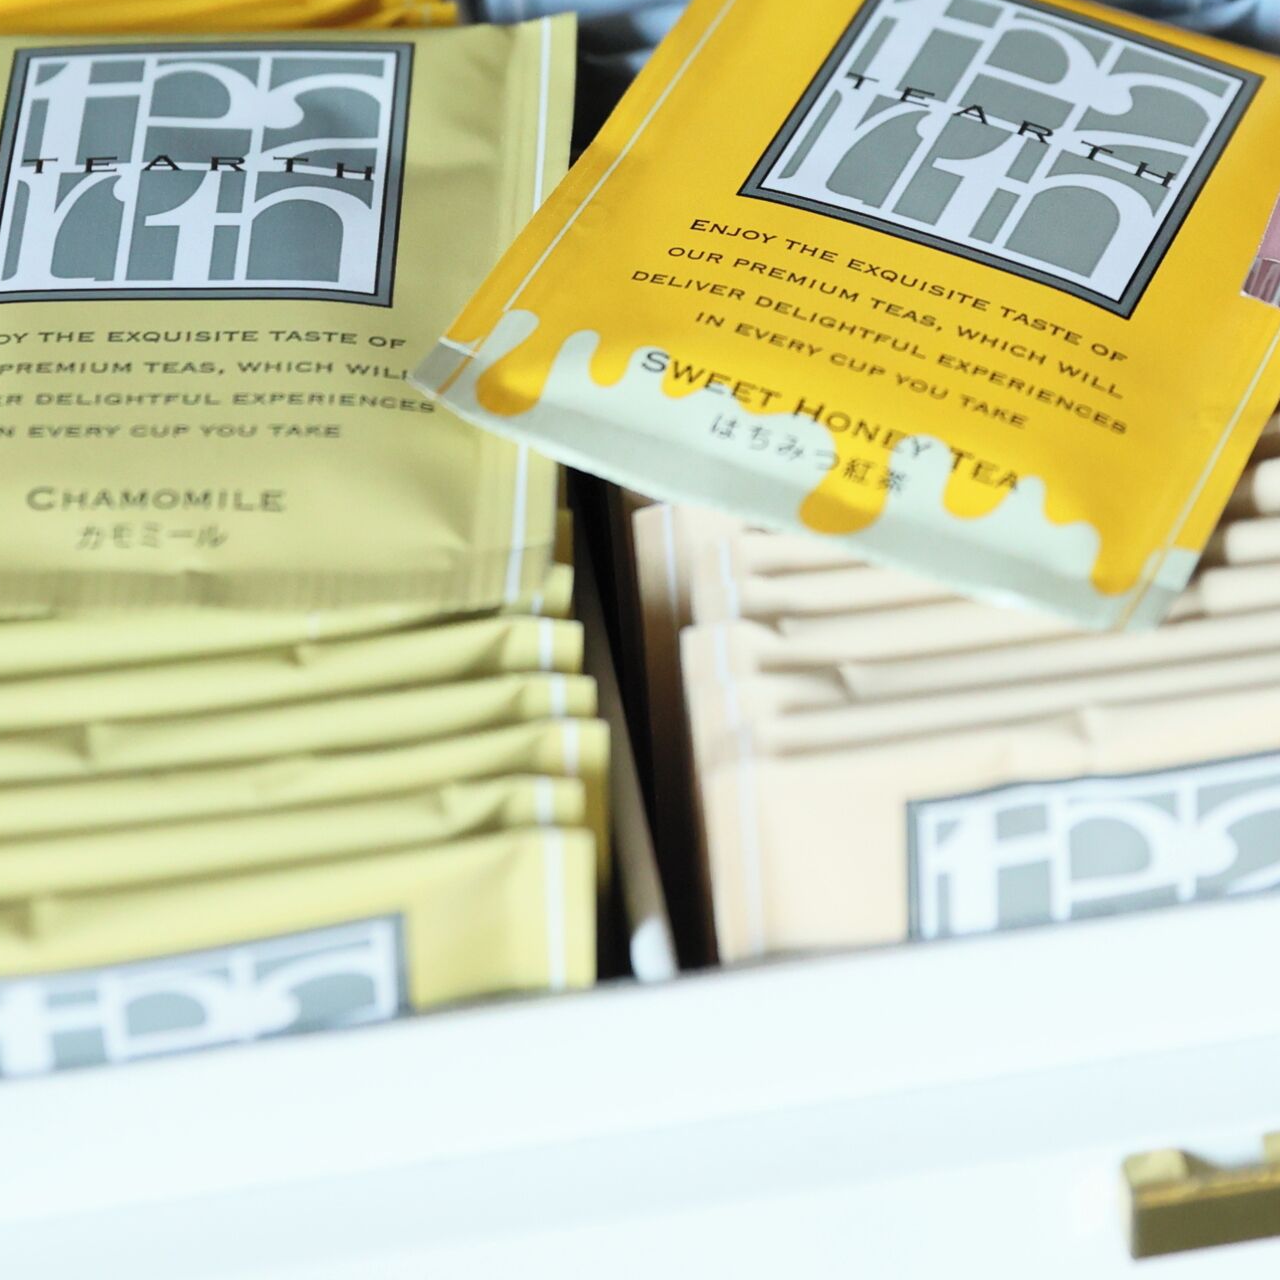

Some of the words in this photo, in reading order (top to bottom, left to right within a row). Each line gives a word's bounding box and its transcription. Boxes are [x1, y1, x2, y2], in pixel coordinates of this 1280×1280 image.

[845, 71, 1176, 188] TEARTH
[23, 154, 375, 182] TEARTH
[689, 218, 778, 245] ENJOY
[784, 238, 839, 264] THE
[847, 259, 992, 312] EXQUISITE
[1000, 305, 1084, 347] TASTE
[1090, 342, 1130, 365] OF
[38, 330, 95, 343] THE
[107, 330, 259, 344] EXQUISITE
[268, 330, 358, 346] TASTE
[367, 335, 407, 350] OF
[667, 246, 725, 266] OUR
[733, 257, 861, 304] PREMIUM
[870, 297, 945, 333] TEAS,
[956, 325, 1048, 367] WHICH
[1057, 361, 1125, 400] WILL
[143, 361, 226, 376] TEAS,
[237, 361, 334, 375] WHICH
[631, 270, 747, 303] DELIVER
[754, 295, 928, 360] DELIGHTFUL
[937, 354, 1129, 436] EXPERIENCES
[695, 312, 726, 329] IN
[734, 322, 823, 357] EVERY
[829, 353, 887, 378] CUP
[896, 372, 950, 401] YOU
[959, 394, 1029, 430] TAKE
[35, 392, 220, 408] DELIGHTFUL
[232, 393, 436, 415] EXPERIENCES
[641, 350, 783, 409] SWEET
[793, 397, 933, 459] HONEY
[947, 445, 1020, 493] TEA
[28, 425, 121, 440] EVERY
[129, 425, 190, 440] CUP
[200, 424, 259, 439] YOU
[270, 424, 342, 439] TAKE
[709, 415, 910, 495] はちみつ紅茶
[25, 485, 287, 512] CHAMOMILE
[75, 522, 229, 550] カモミール
